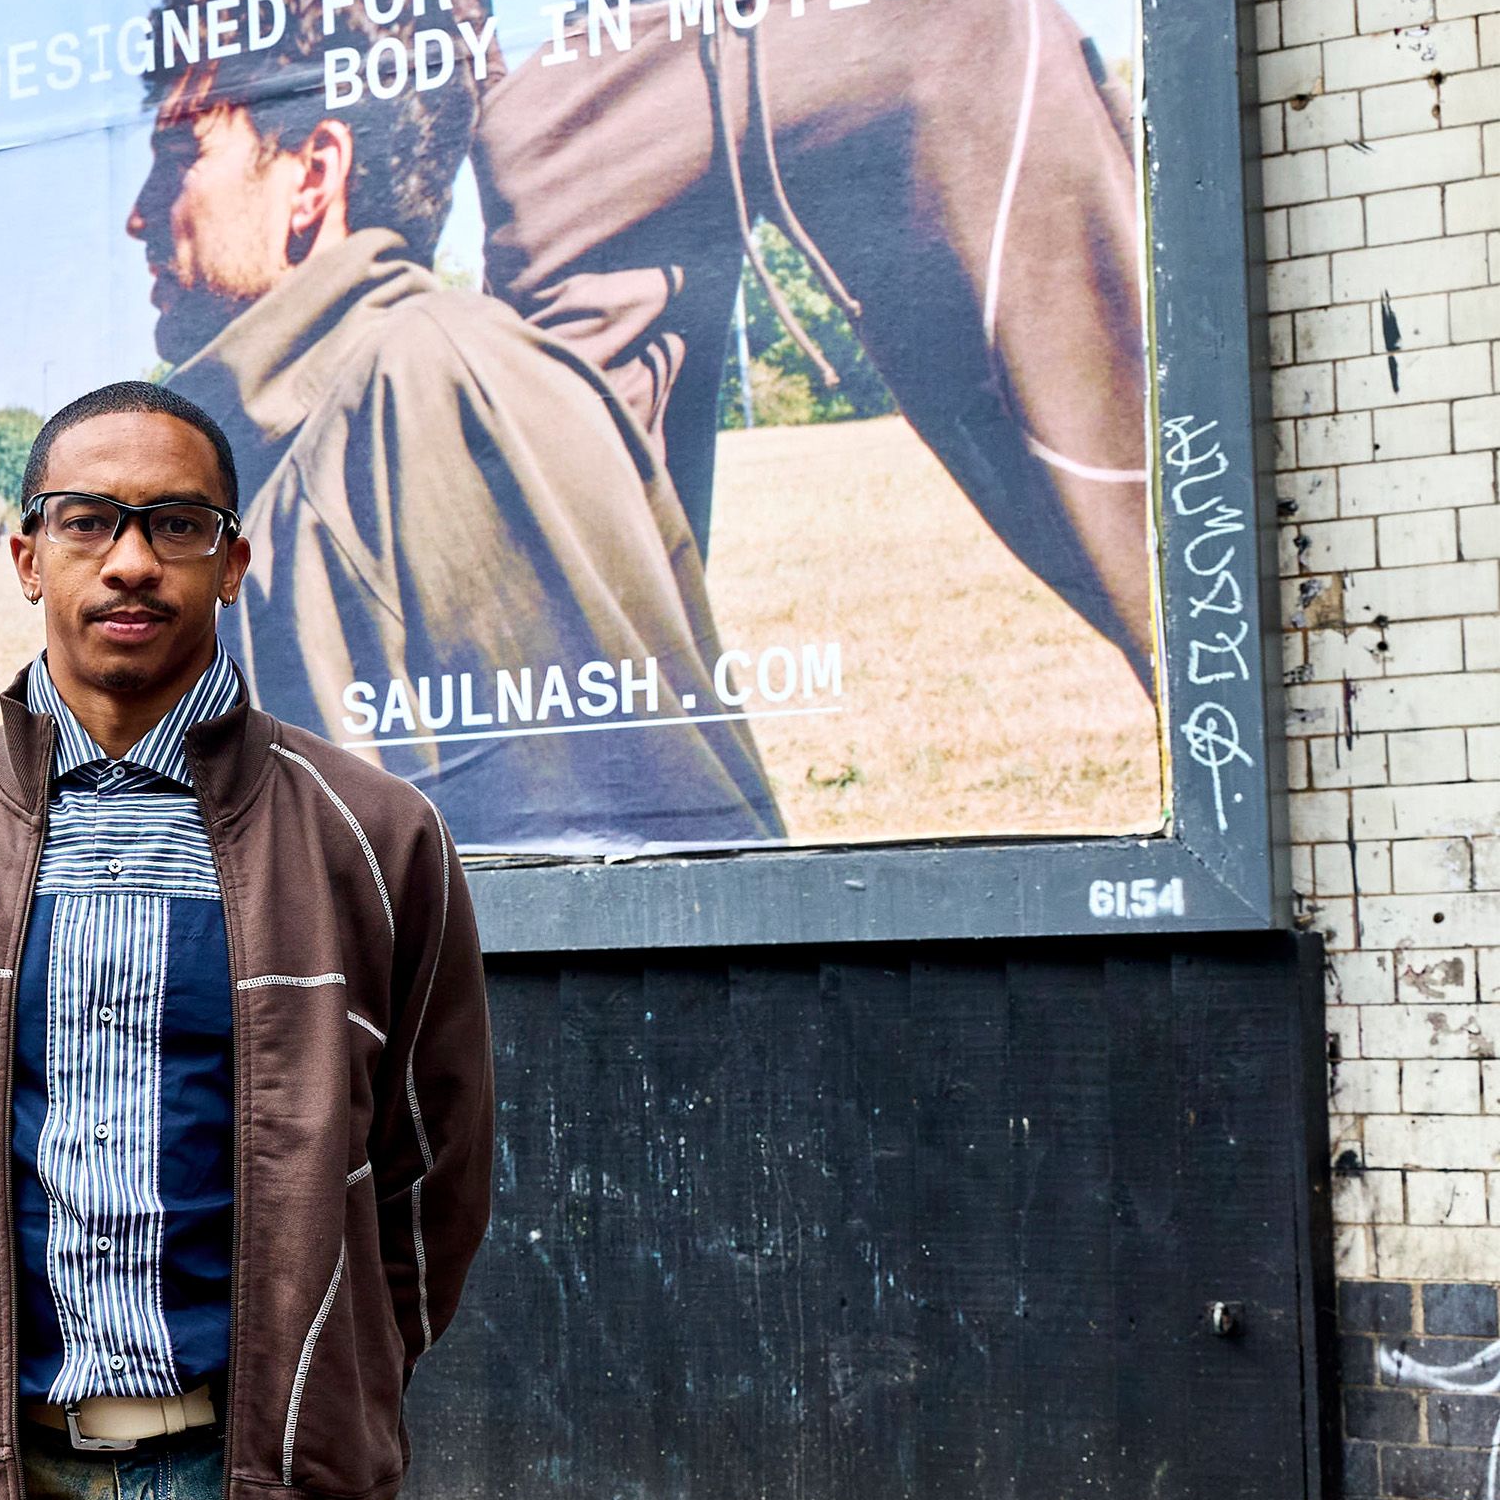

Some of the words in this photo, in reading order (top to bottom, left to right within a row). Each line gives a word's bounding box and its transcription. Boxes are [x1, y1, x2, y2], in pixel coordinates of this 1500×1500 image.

[321, 3, 498, 112] BODY
[341, 641, 843, 736] SAULNASH.COM
[1088, 878, 1186, 918] 6154
